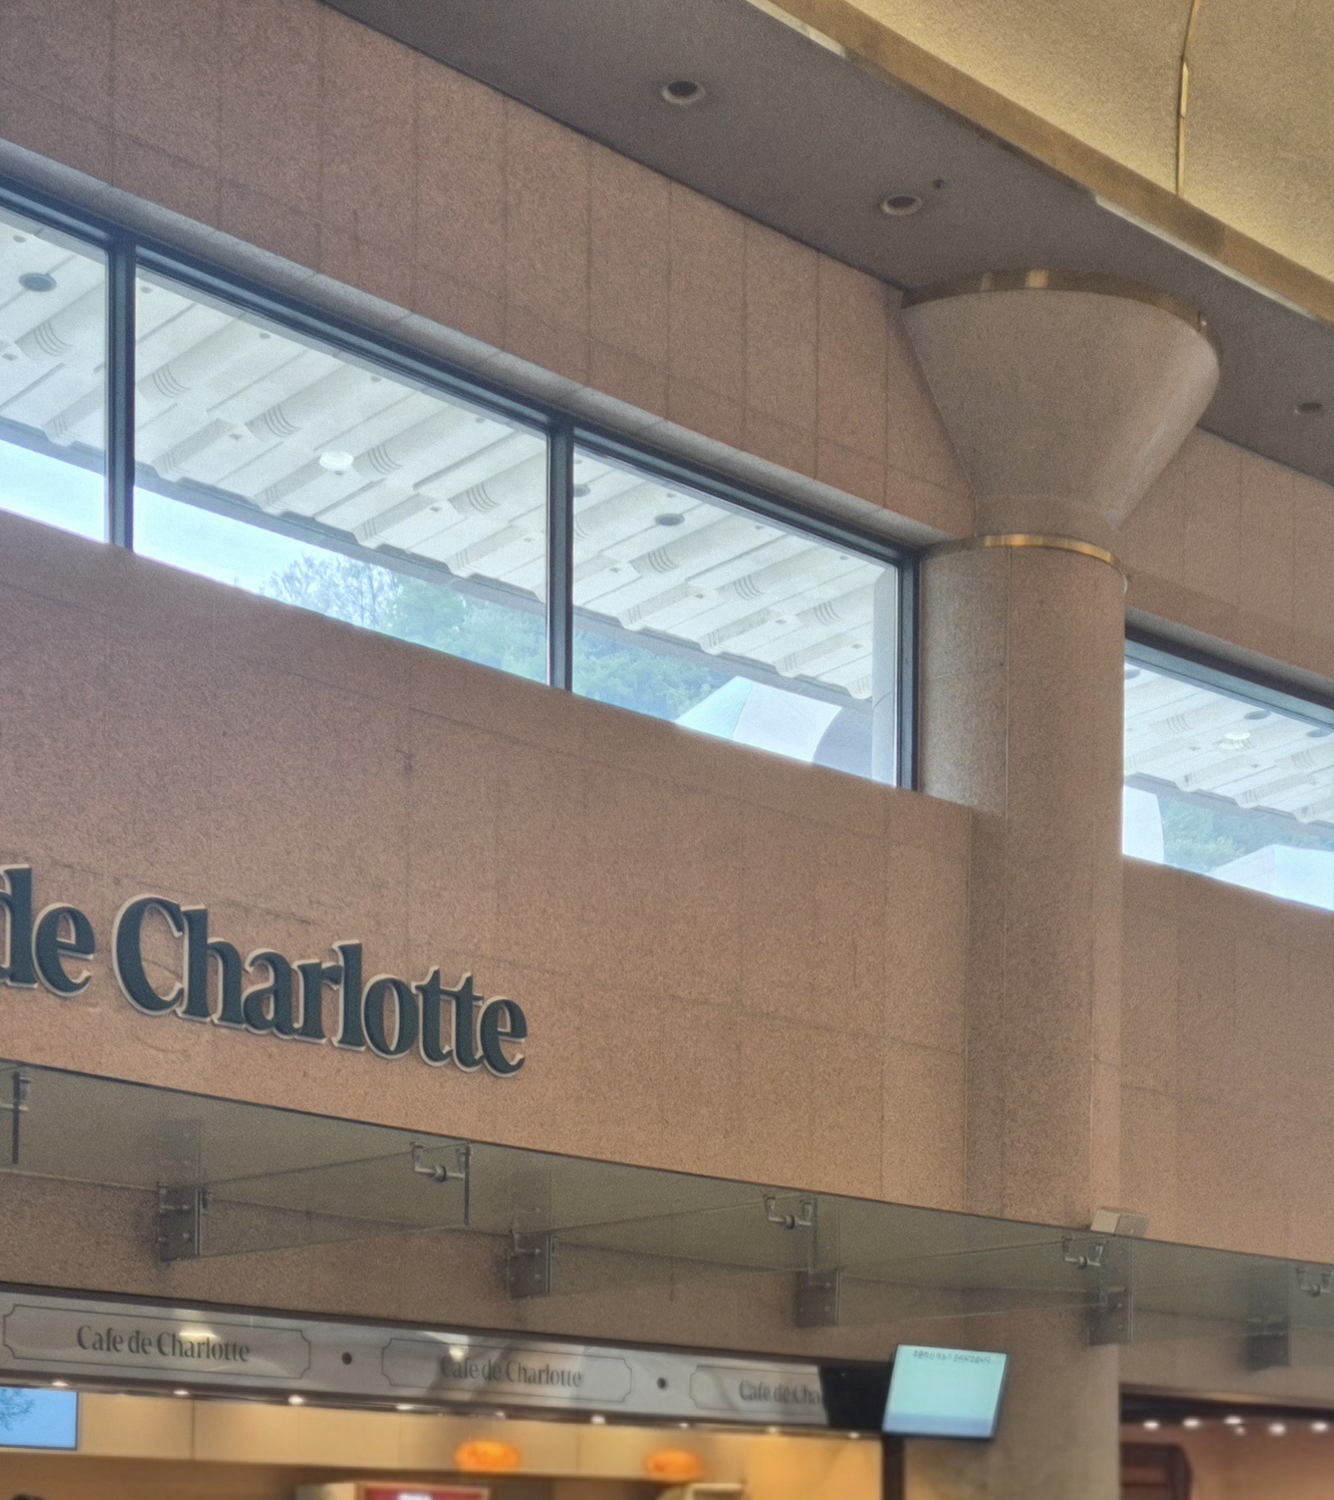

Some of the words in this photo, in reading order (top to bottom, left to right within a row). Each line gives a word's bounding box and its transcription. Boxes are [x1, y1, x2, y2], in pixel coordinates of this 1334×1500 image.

[113, 894, 528, 1076] Charlotte
[77, 1325, 124, 1353] Cafe
[127, 1330, 152, 1355] de
[157, 1331, 250, 1362] Charlotte
[440, 1356, 479, 1379] Cafe
[482, 1359, 502, 1381] de
[505, 1360, 583, 1387] Charlotte
